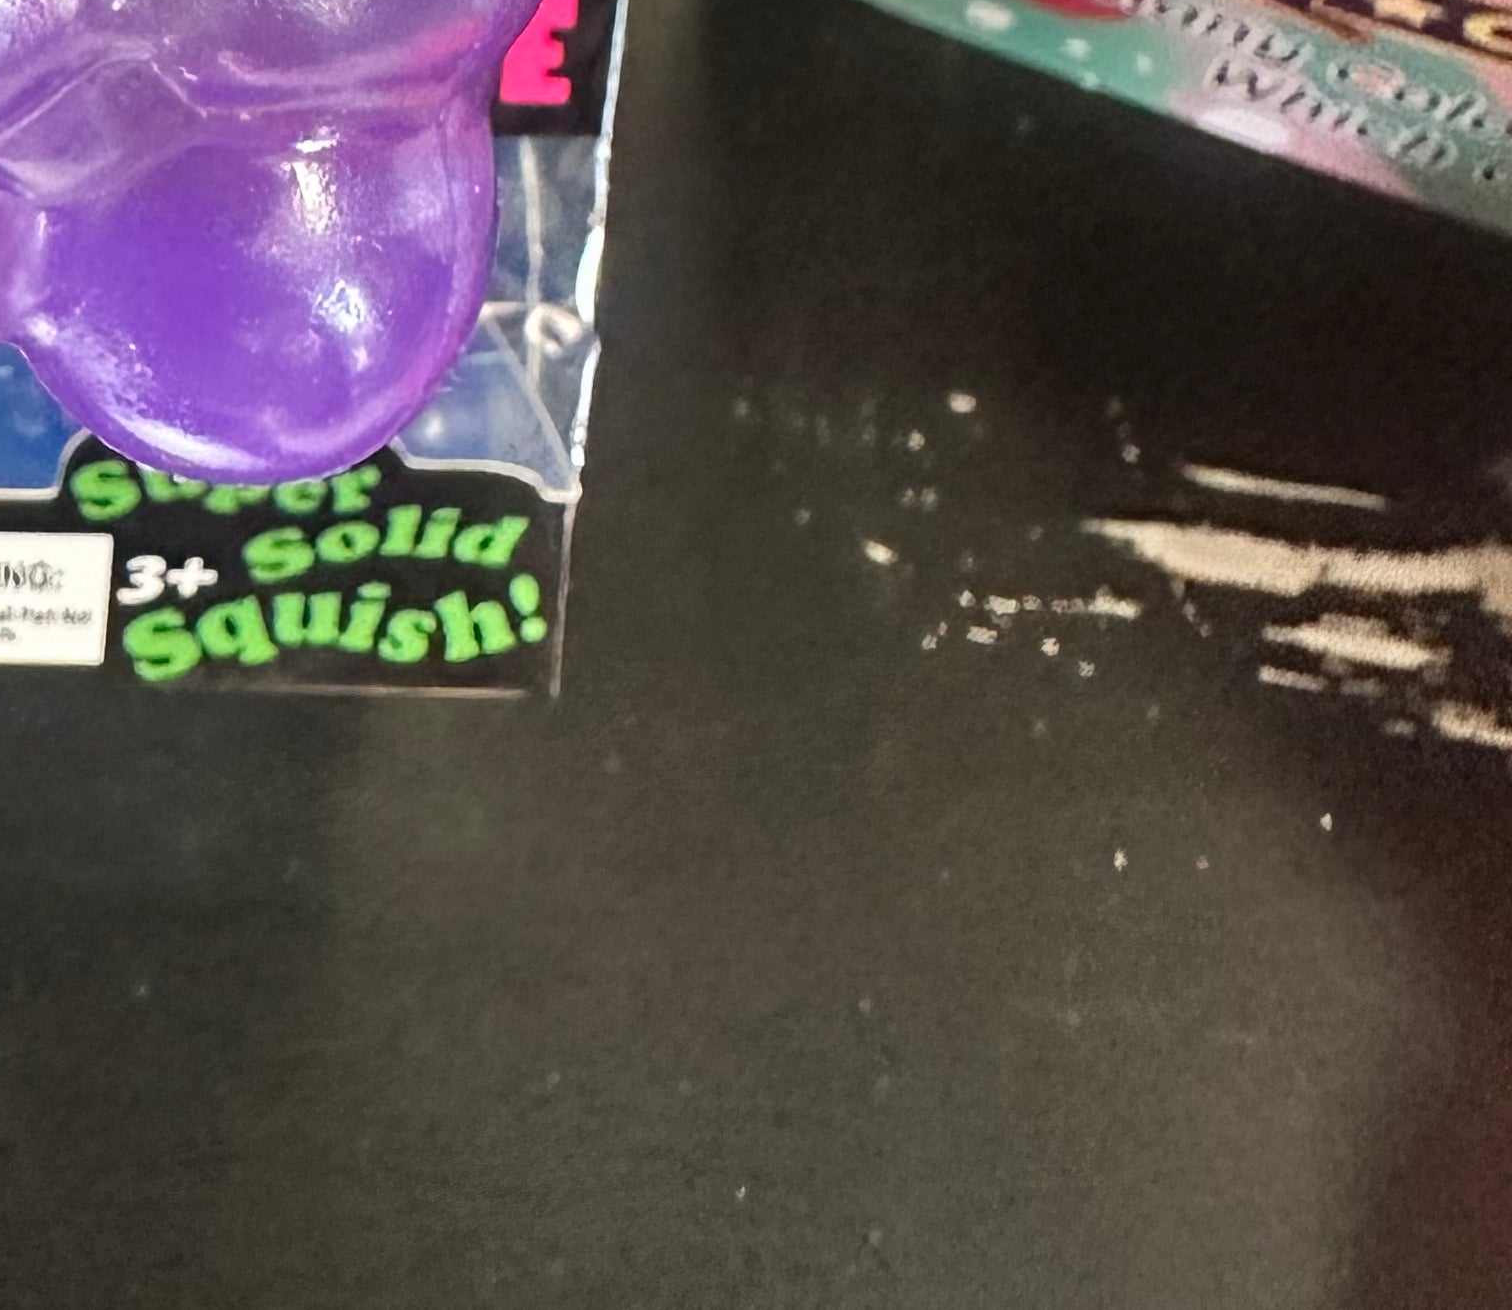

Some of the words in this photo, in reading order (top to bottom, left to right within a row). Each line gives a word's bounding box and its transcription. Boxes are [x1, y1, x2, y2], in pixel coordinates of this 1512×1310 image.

[116, 554, 220, 605] 3+
[241, 505, 530, 582] Solid
[123, 575, 549, 682] Squish!
